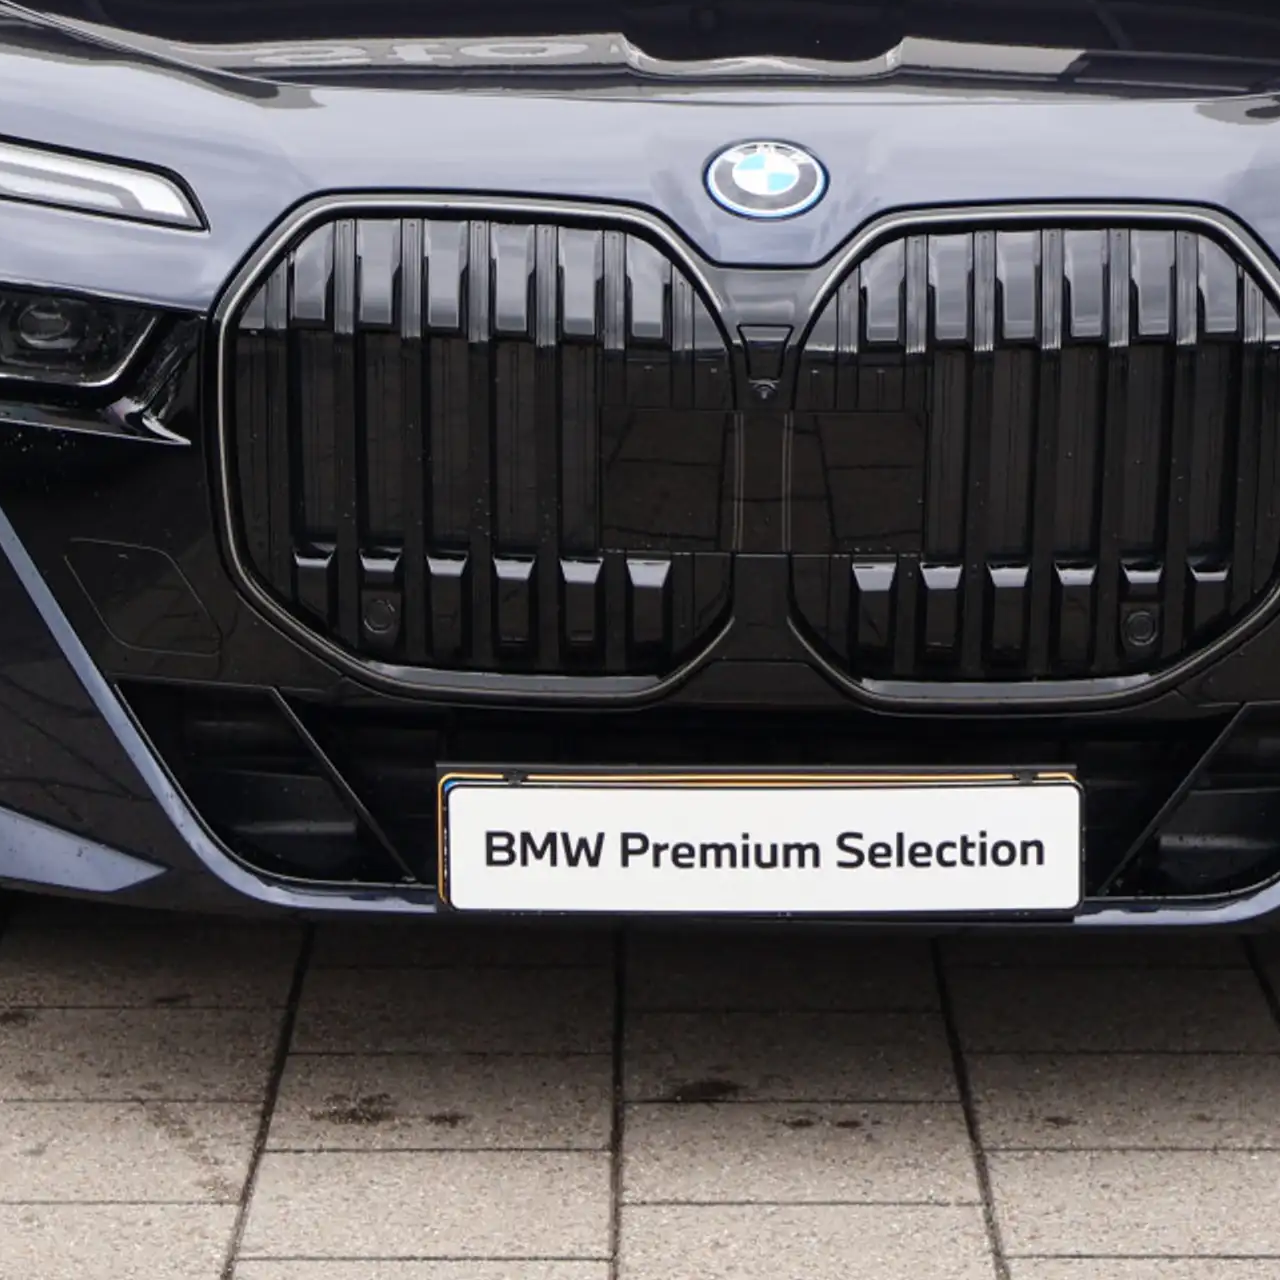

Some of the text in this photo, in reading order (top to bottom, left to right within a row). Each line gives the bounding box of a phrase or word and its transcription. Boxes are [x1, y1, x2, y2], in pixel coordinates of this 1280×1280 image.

[483, 830, 1045, 868] BMW Premium Selection
